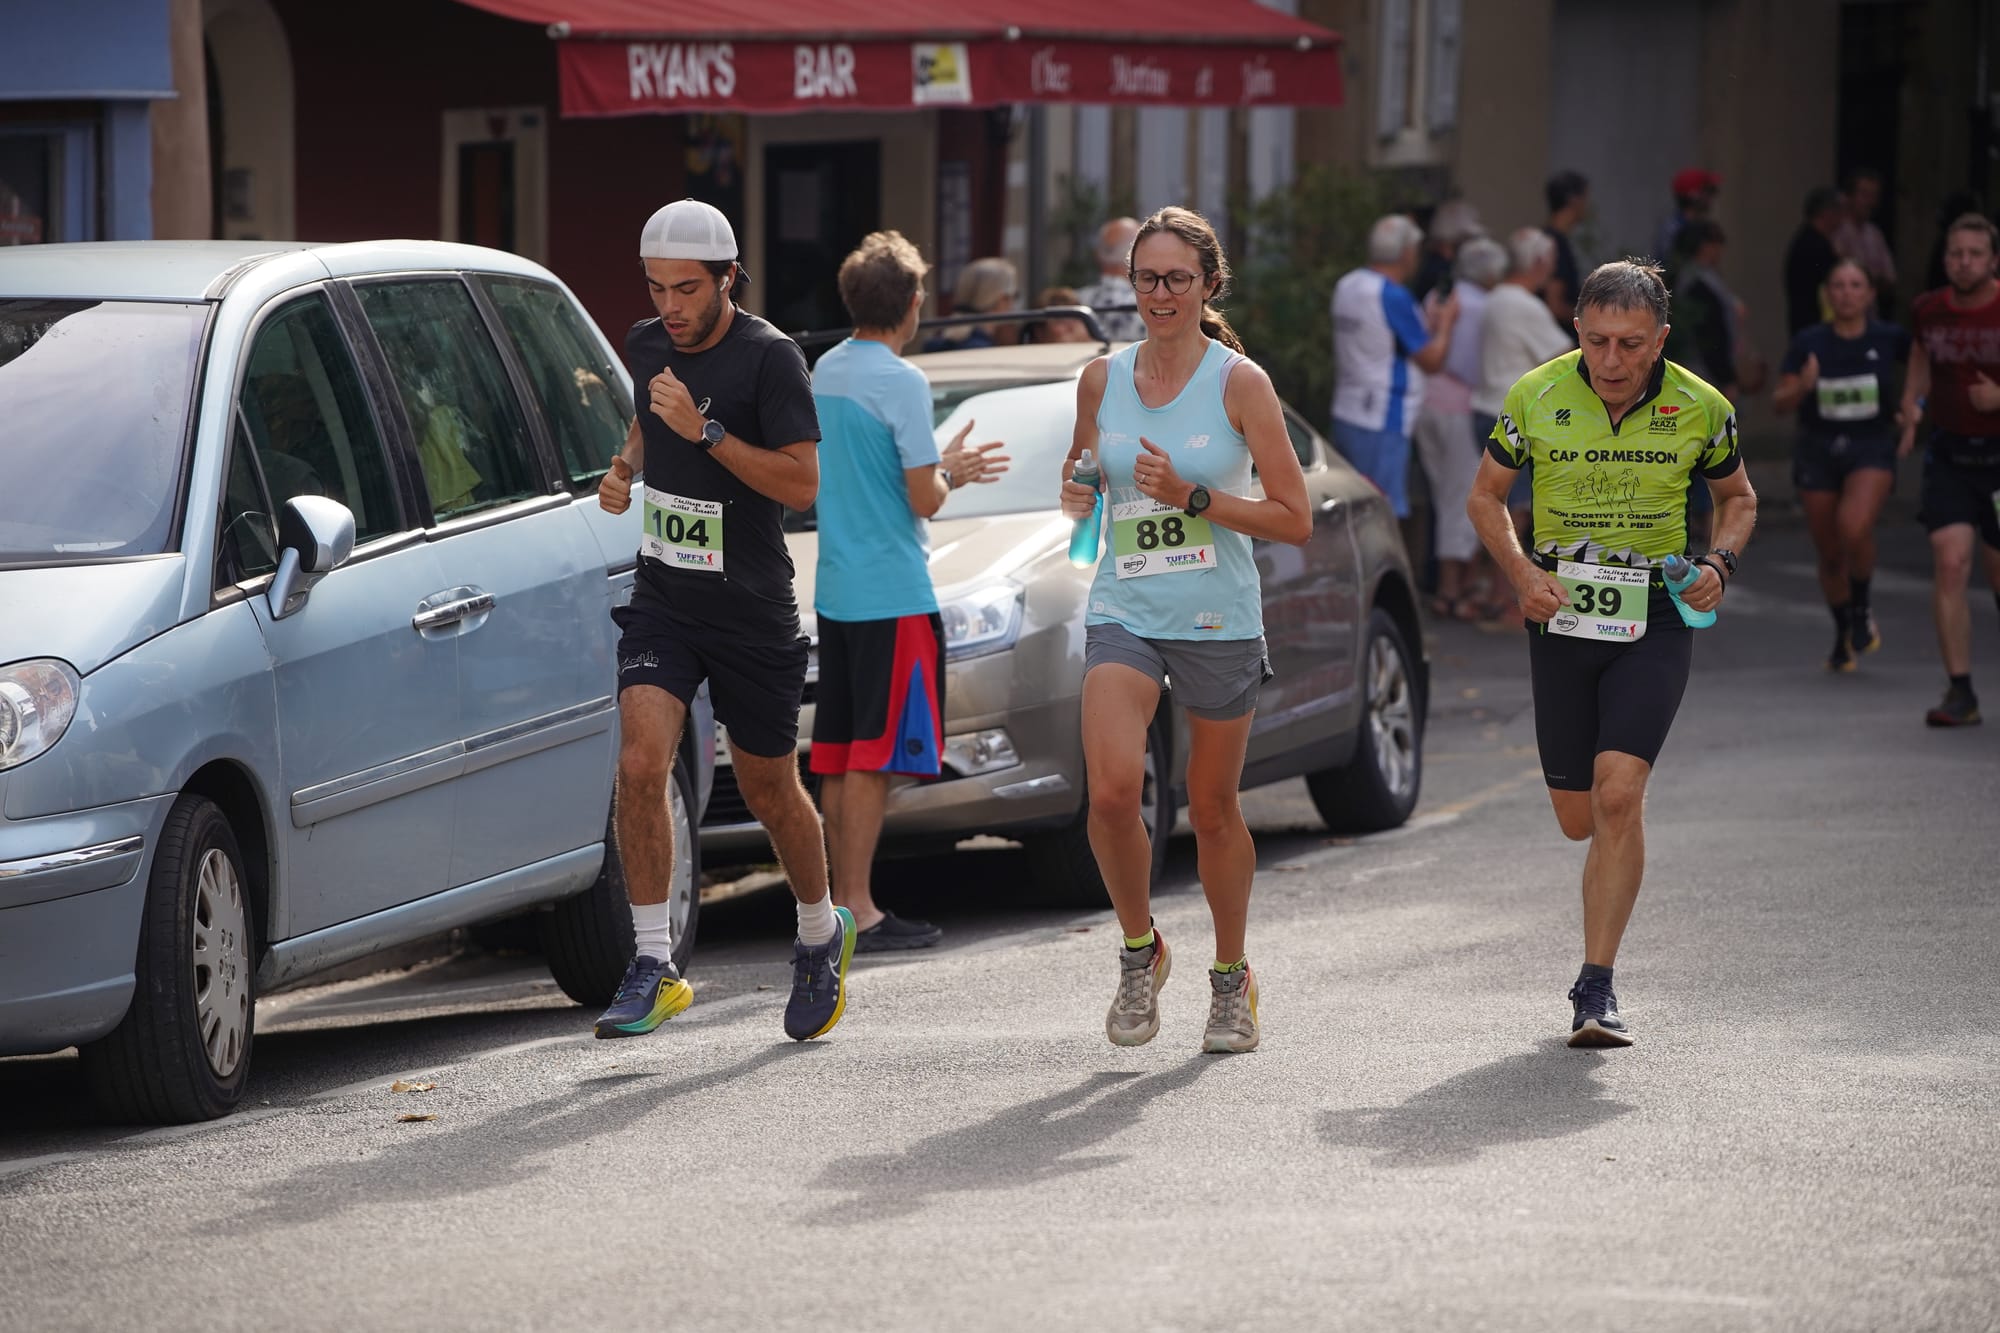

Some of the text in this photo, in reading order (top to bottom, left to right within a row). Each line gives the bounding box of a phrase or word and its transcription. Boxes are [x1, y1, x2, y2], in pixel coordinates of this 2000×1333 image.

[627, 42, 736, 100] RYAN'S
[794, 42, 857, 98] BAR
[1549, 449, 1678, 464] CAP ORMESSON
[1627, 511, 1671, 519] ORMESSON
[652, 509, 709, 547] 104
[1563, 520, 1611, 528] COURSE
[1136, 516, 1185, 550] 88
[676, 552, 704, 561] TUFF'S
[1165, 553, 1197, 563] TUFF'S
[1123, 560, 1143, 569] BFP
[1573, 584, 1622, 616] 39
[1556, 618, 1576, 627] BFP
[1596, 623, 1627, 633] TUFF'S
